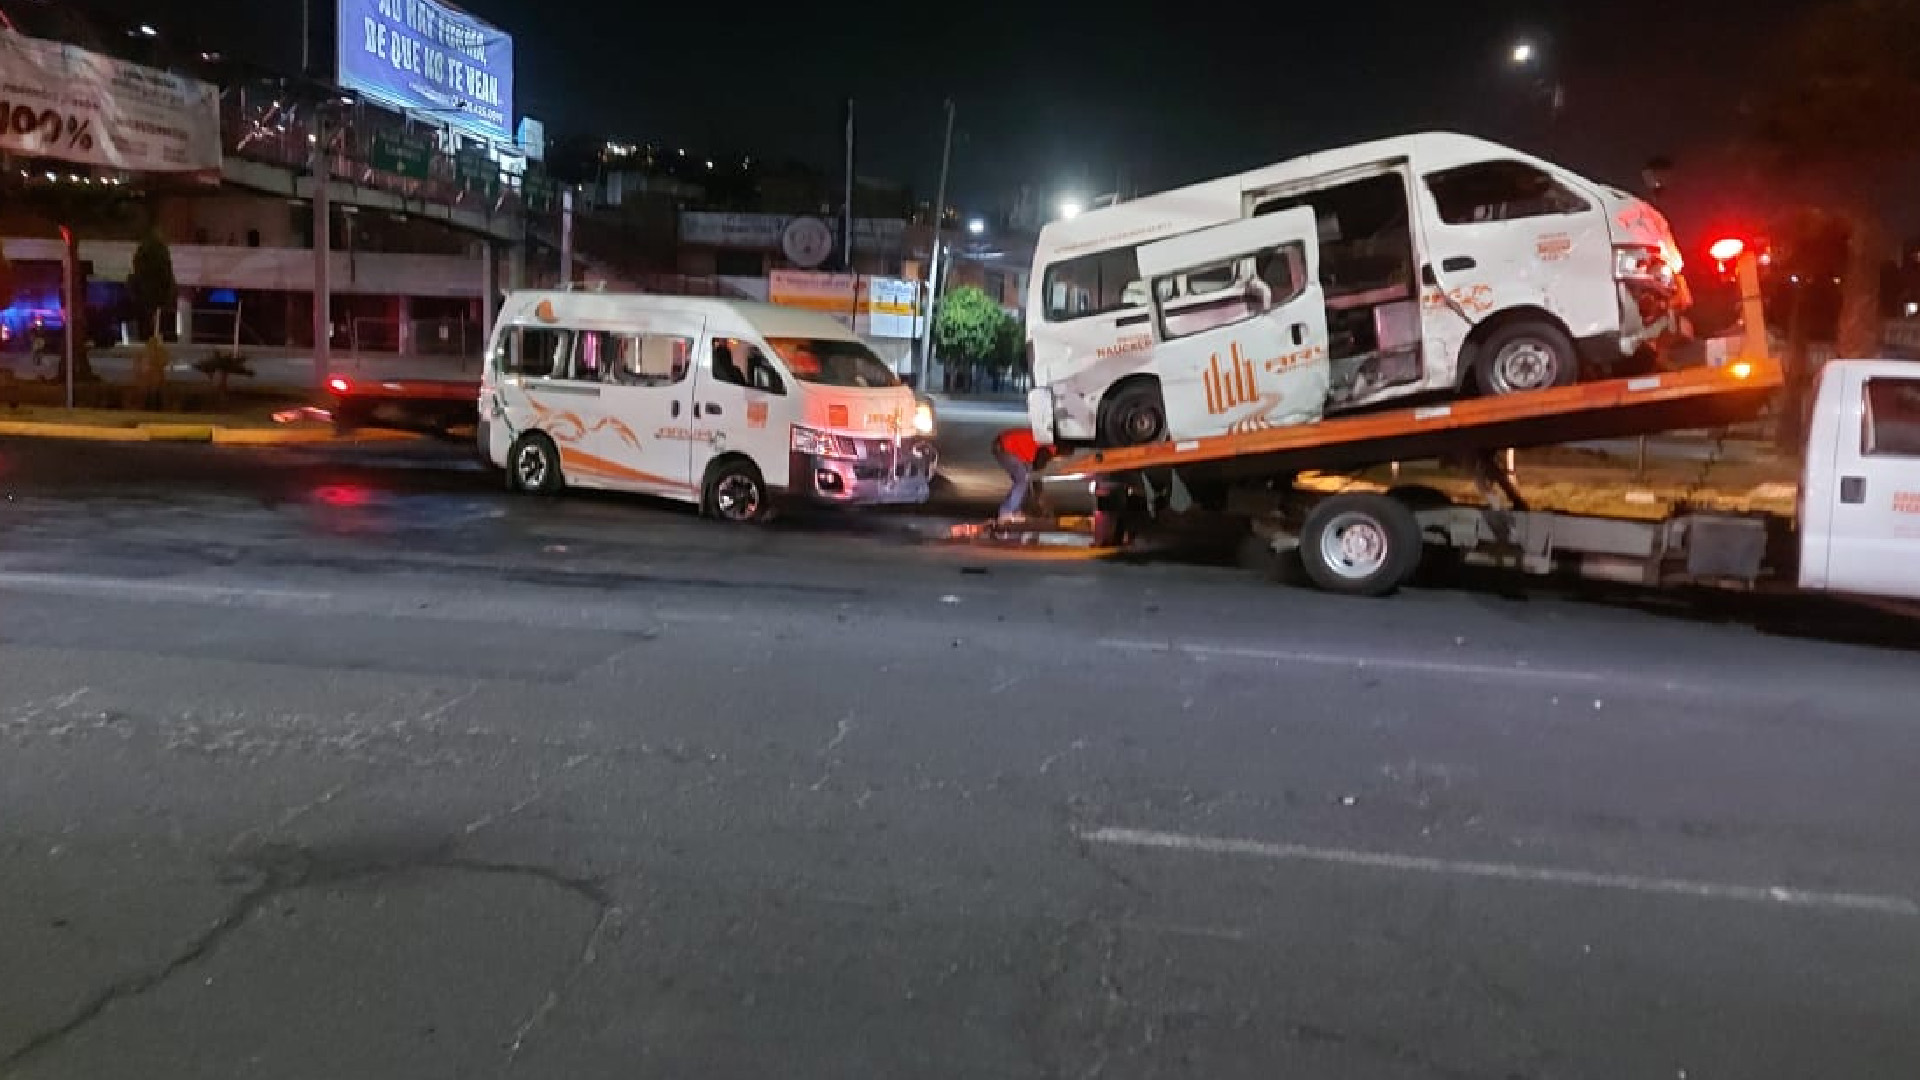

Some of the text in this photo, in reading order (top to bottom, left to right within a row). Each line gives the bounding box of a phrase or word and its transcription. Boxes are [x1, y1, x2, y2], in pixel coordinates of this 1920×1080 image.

[365, 16, 386, 59] DE
[391, 30, 421, 74] QUE
[424, 46, 443, 84] NO
[448, 57, 464, 92] TE
